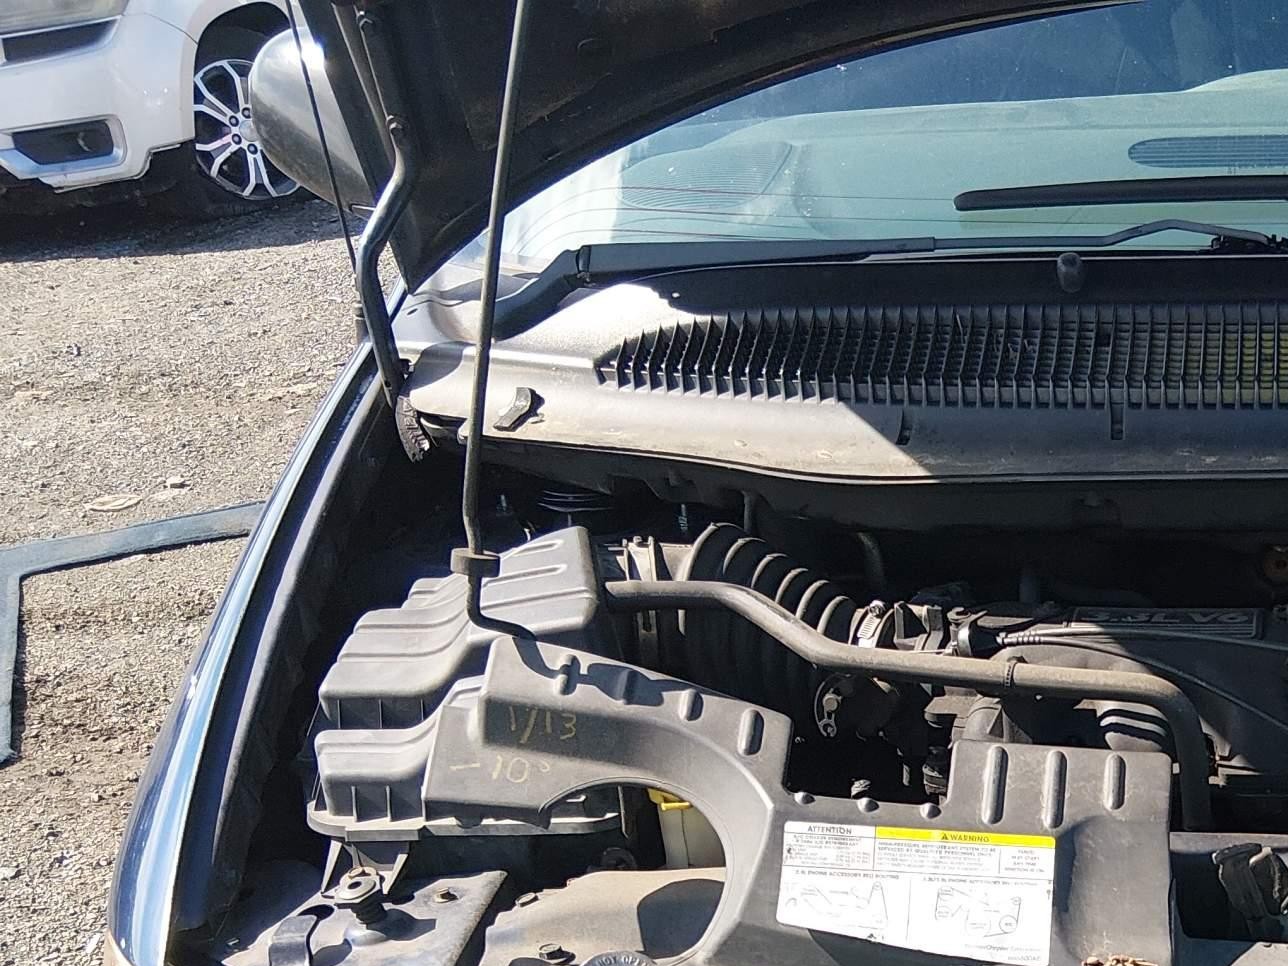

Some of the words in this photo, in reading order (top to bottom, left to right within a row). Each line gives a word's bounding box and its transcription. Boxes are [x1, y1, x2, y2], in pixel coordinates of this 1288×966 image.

[1081, 611, 1180, 623] 3.3L
[1188, 611, 1249, 623] V6
[508, 705, 578, 744] 1/13
[807, 825, 853, 835] ATTENTION
[950, 833, 991, 843] WARNING
